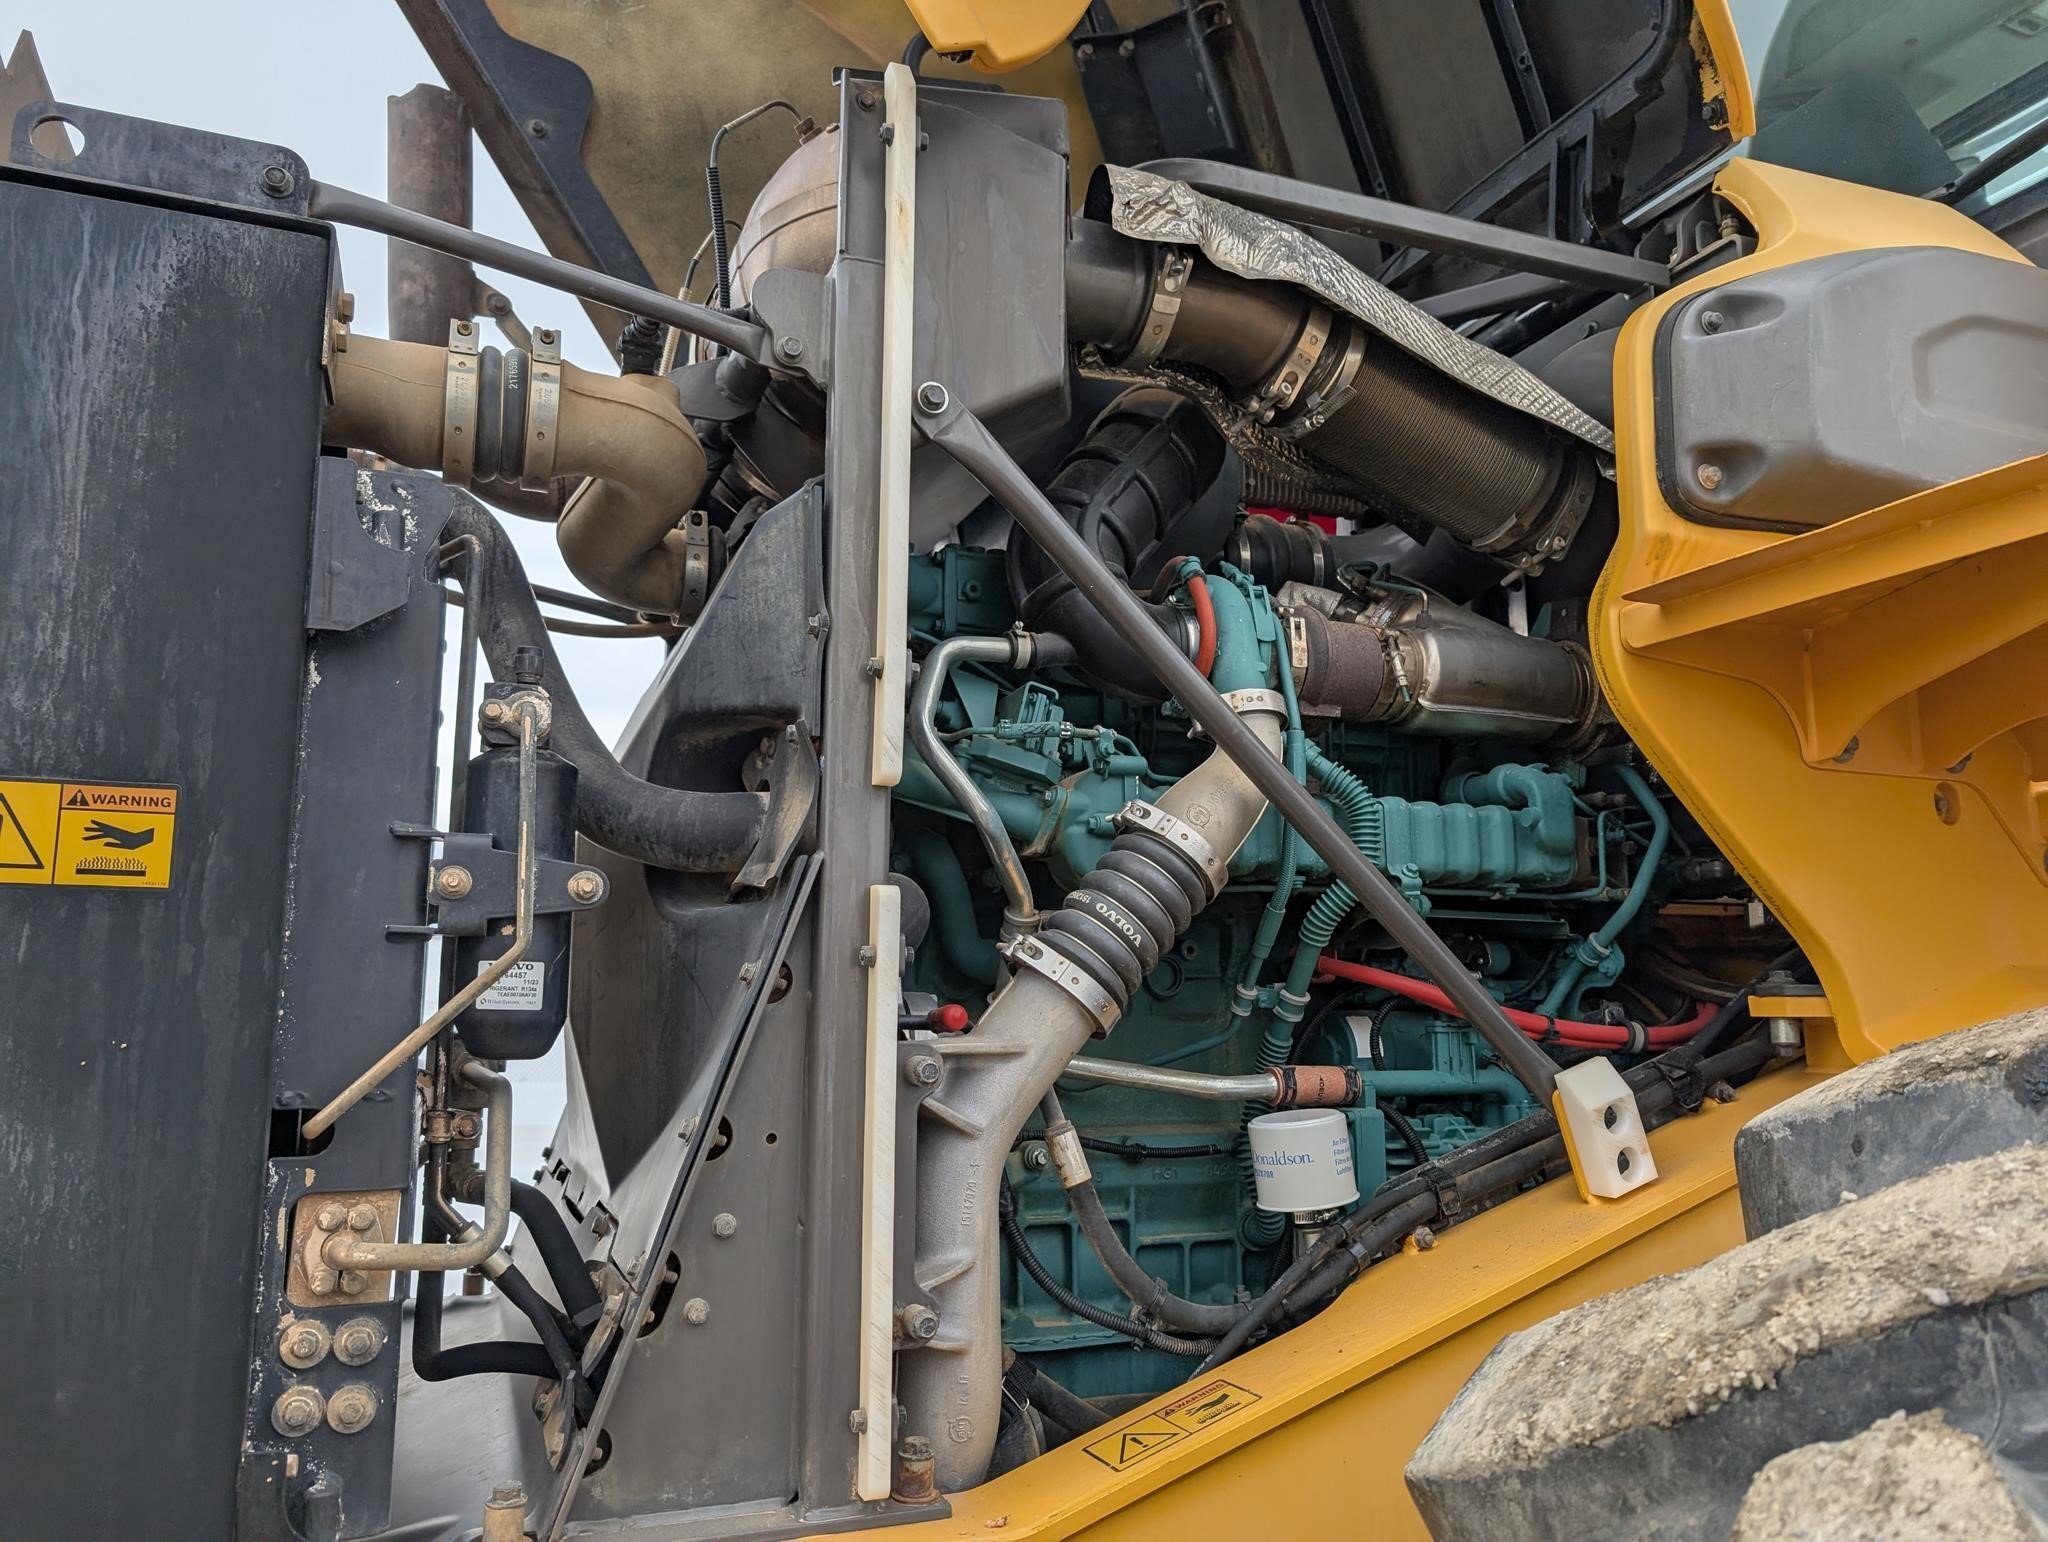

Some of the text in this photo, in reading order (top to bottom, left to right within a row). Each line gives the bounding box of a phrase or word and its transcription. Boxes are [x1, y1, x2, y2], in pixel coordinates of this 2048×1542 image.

[91, 793, 172, 808] WARNING
[1095, 902, 1143, 948] VOLVO
[1174, 1382, 1226, 1408] WARNING
